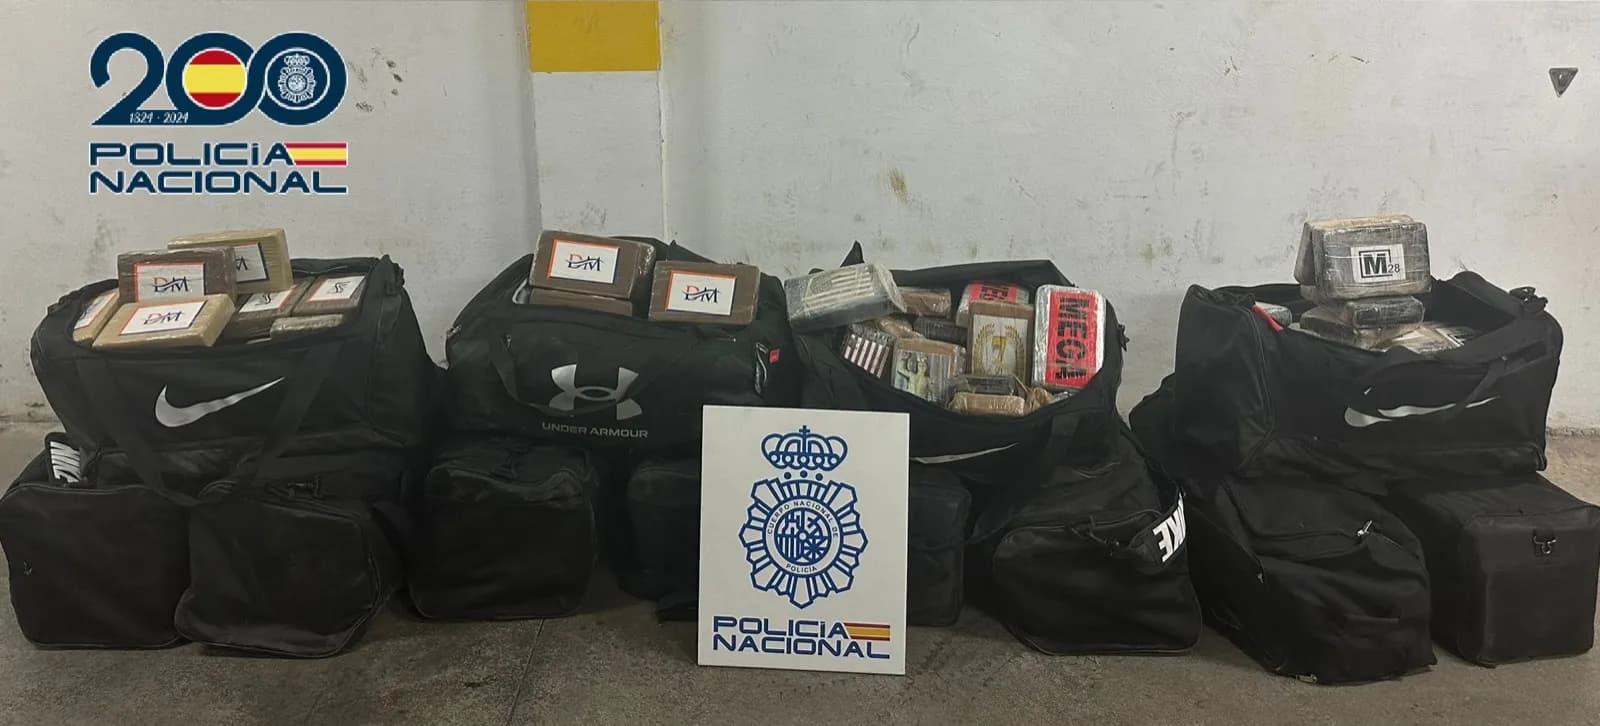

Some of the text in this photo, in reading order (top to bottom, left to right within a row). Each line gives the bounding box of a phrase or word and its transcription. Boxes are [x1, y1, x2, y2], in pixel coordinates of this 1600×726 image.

[568, 253, 602, 272] DM
[153, 276, 190, 293] DM
[684, 285, 719, 303] DM
[143, 311, 182, 325] DM
[1056, 297, 1089, 380] MEGA
[542, 421, 649, 439] UNDER ARMOUR
[767, 500, 839, 537] CUERPO NACIONAL DE
[713, 634, 891, 660] NACIONAL
